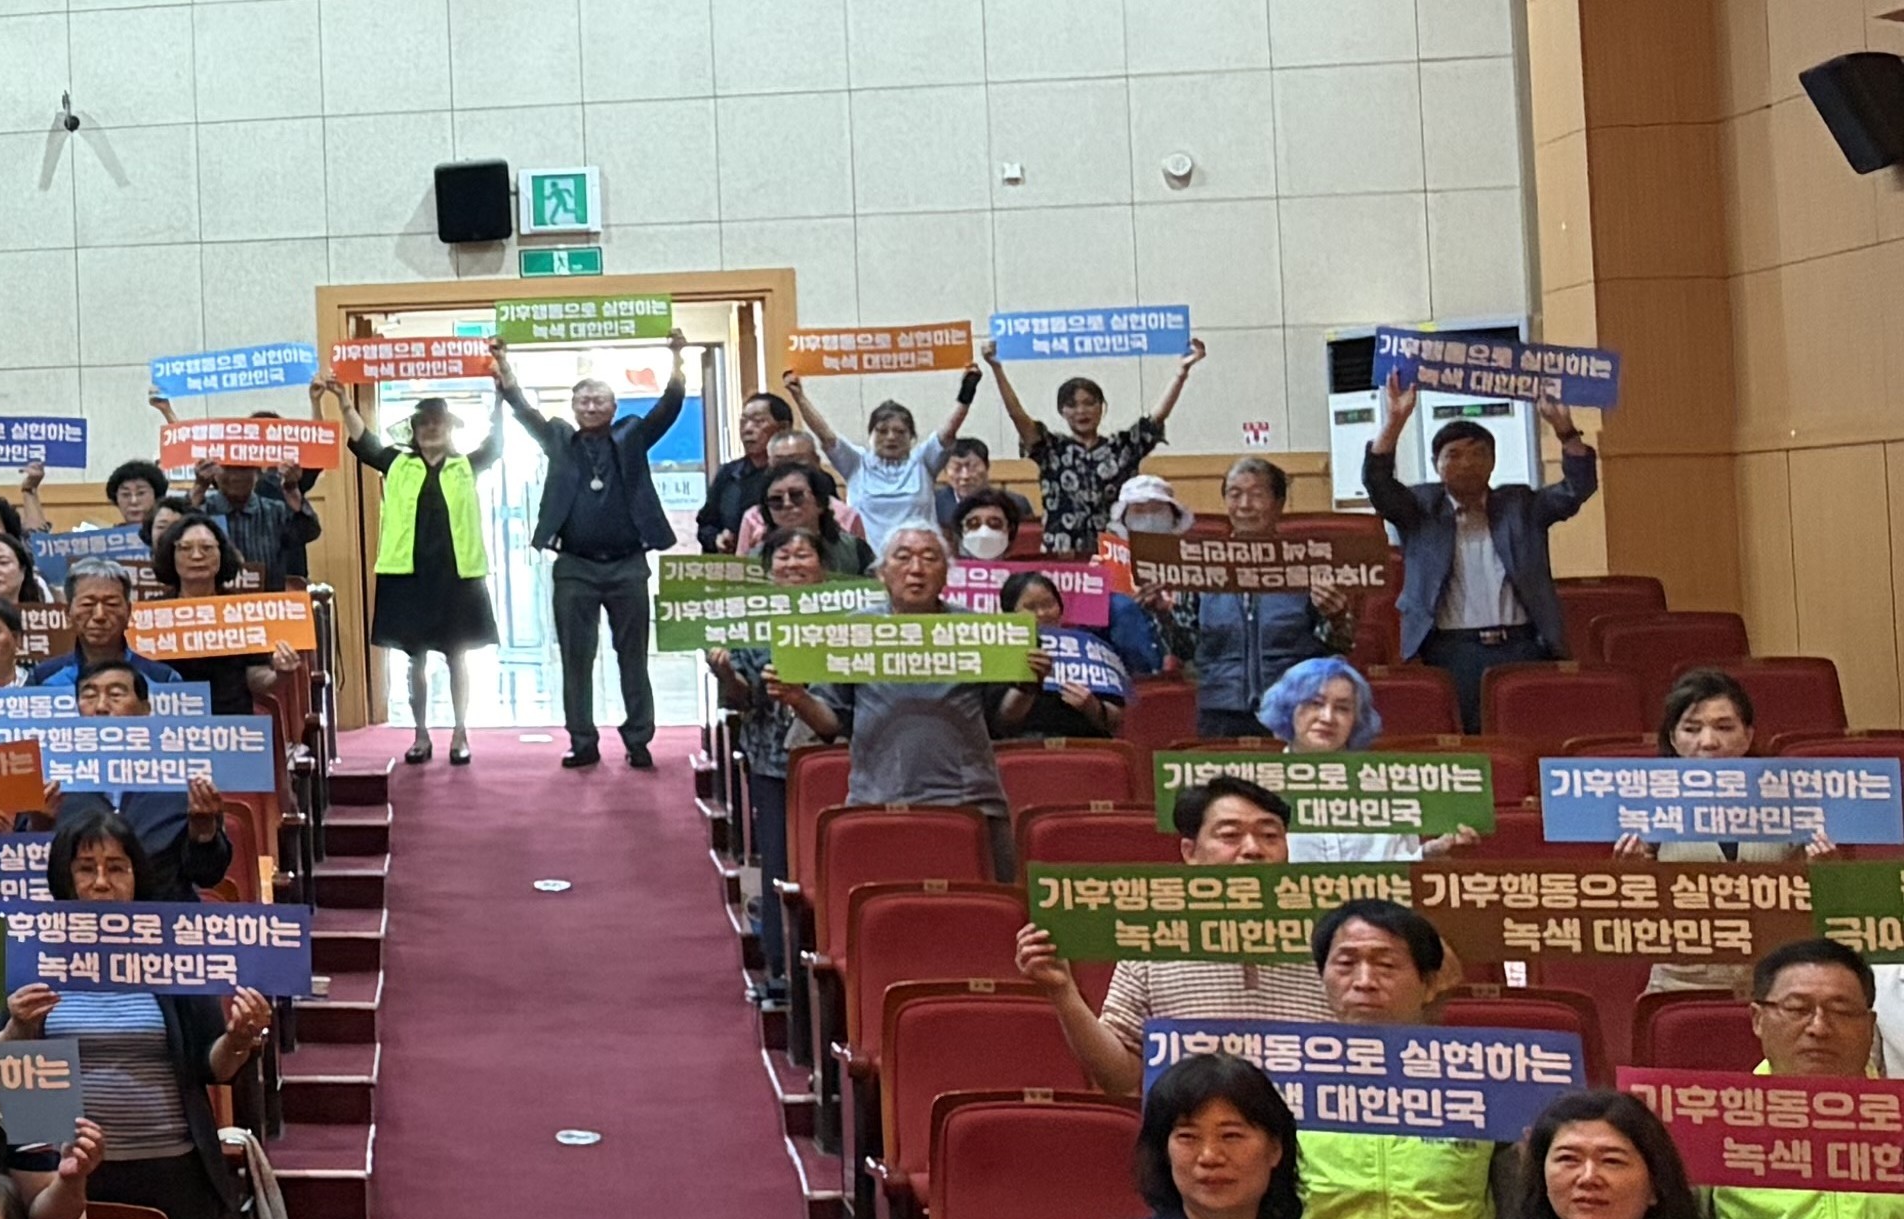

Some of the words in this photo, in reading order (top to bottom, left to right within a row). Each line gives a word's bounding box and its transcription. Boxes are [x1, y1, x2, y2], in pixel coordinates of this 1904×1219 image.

[12, 423, 81, 441] 실현하는
[164, 424, 259, 445] 기후행동으로
[266, 425, 334, 444] 실현하는
[778, 623, 923, 646] 기후행동으로
[932, 623, 1029, 645] 실현하는
[827, 653, 875, 675] 녹색
[883, 652, 981, 675] 대한민국
[1551, 769, 1747, 798] 기후행동으로
[1758, 770, 1891, 799] 실현하는
[1619, 806, 1683, 833] 녹색
[1694, 806, 1827, 841] 대한민국
[1422, 873, 1659, 908] 기후행동으로
[173, 915, 300, 947] 실현하는
[1504, 918, 1581, 952] 녹색
[1593, 918, 1752, 954] 대한민국
[38, 952, 99, 982] 녹색
[110, 953, 237, 985] 대한민국
[1400, 1040, 1571, 1083] 실현하는
[1317, 1085, 1485, 1128] 대한민국
